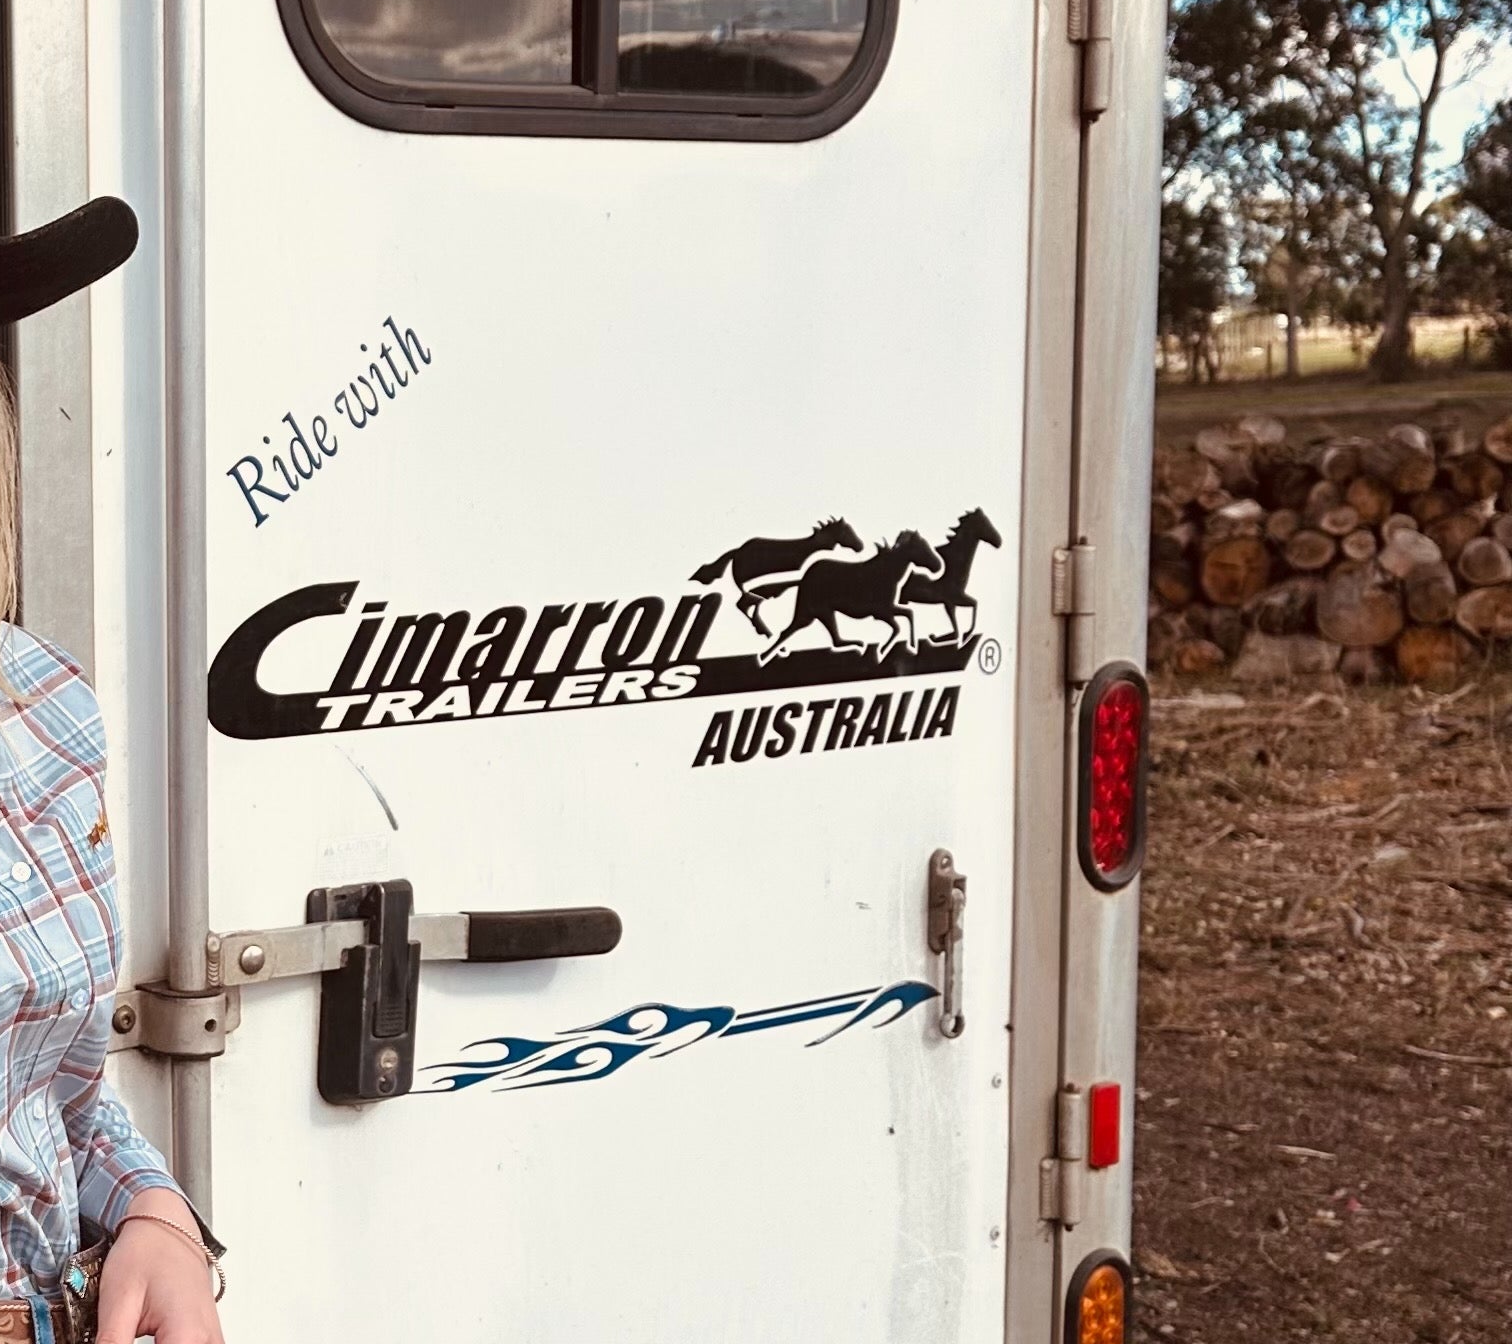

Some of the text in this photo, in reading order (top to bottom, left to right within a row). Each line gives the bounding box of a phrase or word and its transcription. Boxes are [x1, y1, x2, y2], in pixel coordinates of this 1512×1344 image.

[226, 316, 432, 529] Ride with
[207, 579, 725, 741] Cimarron
[317, 664, 701, 732] TRAILERS
[691, 685, 961, 768] AUSTRALIA
